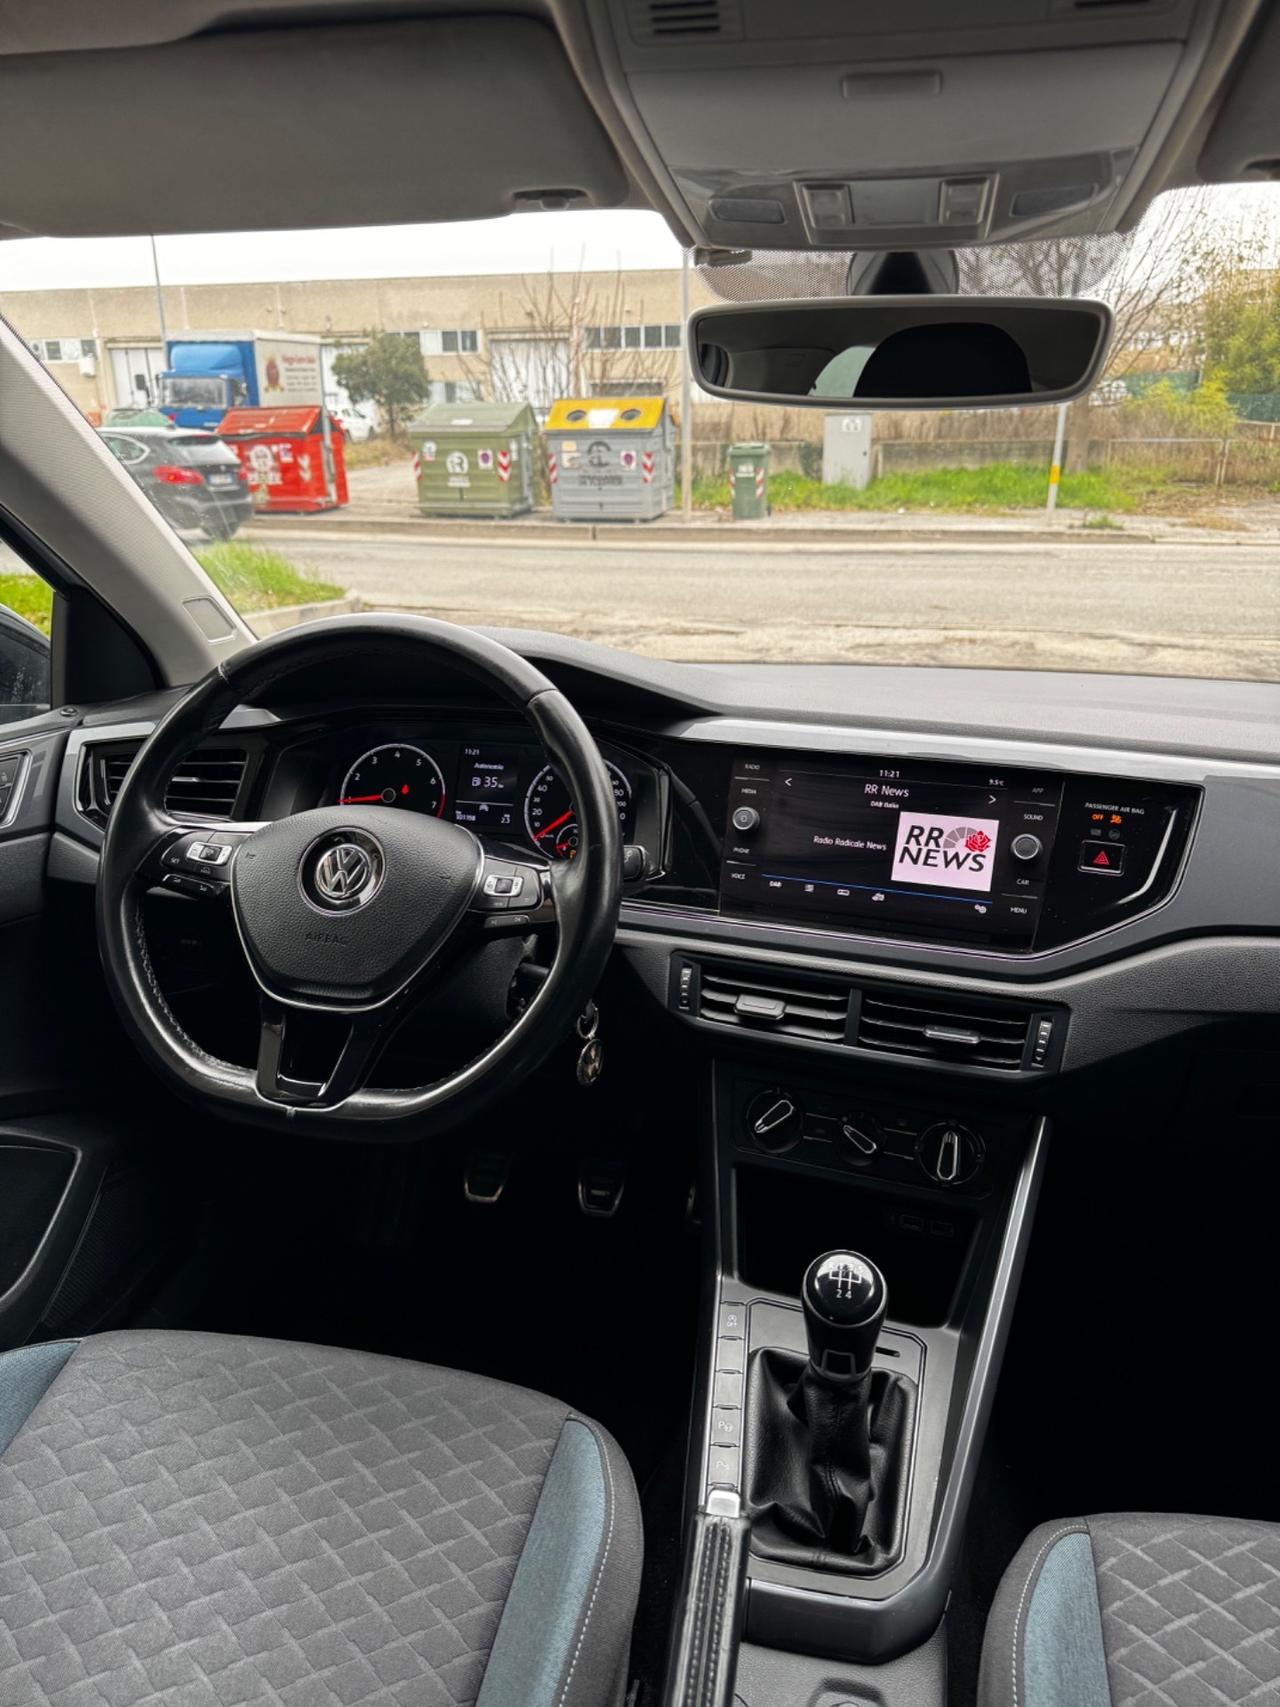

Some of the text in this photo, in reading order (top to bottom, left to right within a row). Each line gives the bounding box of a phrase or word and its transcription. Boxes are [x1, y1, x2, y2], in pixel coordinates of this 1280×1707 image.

[394, 750, 401, 758] 4
[371, 756, 378, 765] 3
[416, 758, 422, 767] 5
[354, 772, 361, 781] 2
[880, 769, 900, 778] 11:21
[430, 777, 437, 785] 6
[484, 776, 498, 788] 35
[864, 783, 909, 798] RR News
[432, 800, 437, 808] 7
[1085, 802, 1120, 811] PASSENGER
[532, 808, 543, 816] 20
[1023, 813, 1044, 821] SOUND
[905, 825, 944, 849] RR
[813, 835, 887, 851] Radio Radicale News
[899, 846, 986, 873] NEWS
[769, 880, 782, 888] DAB
[1016, 878, 1030, 886] CAR
[1010, 906, 1028, 914] MENU
[836, 1289, 852, 1300] 2 4
